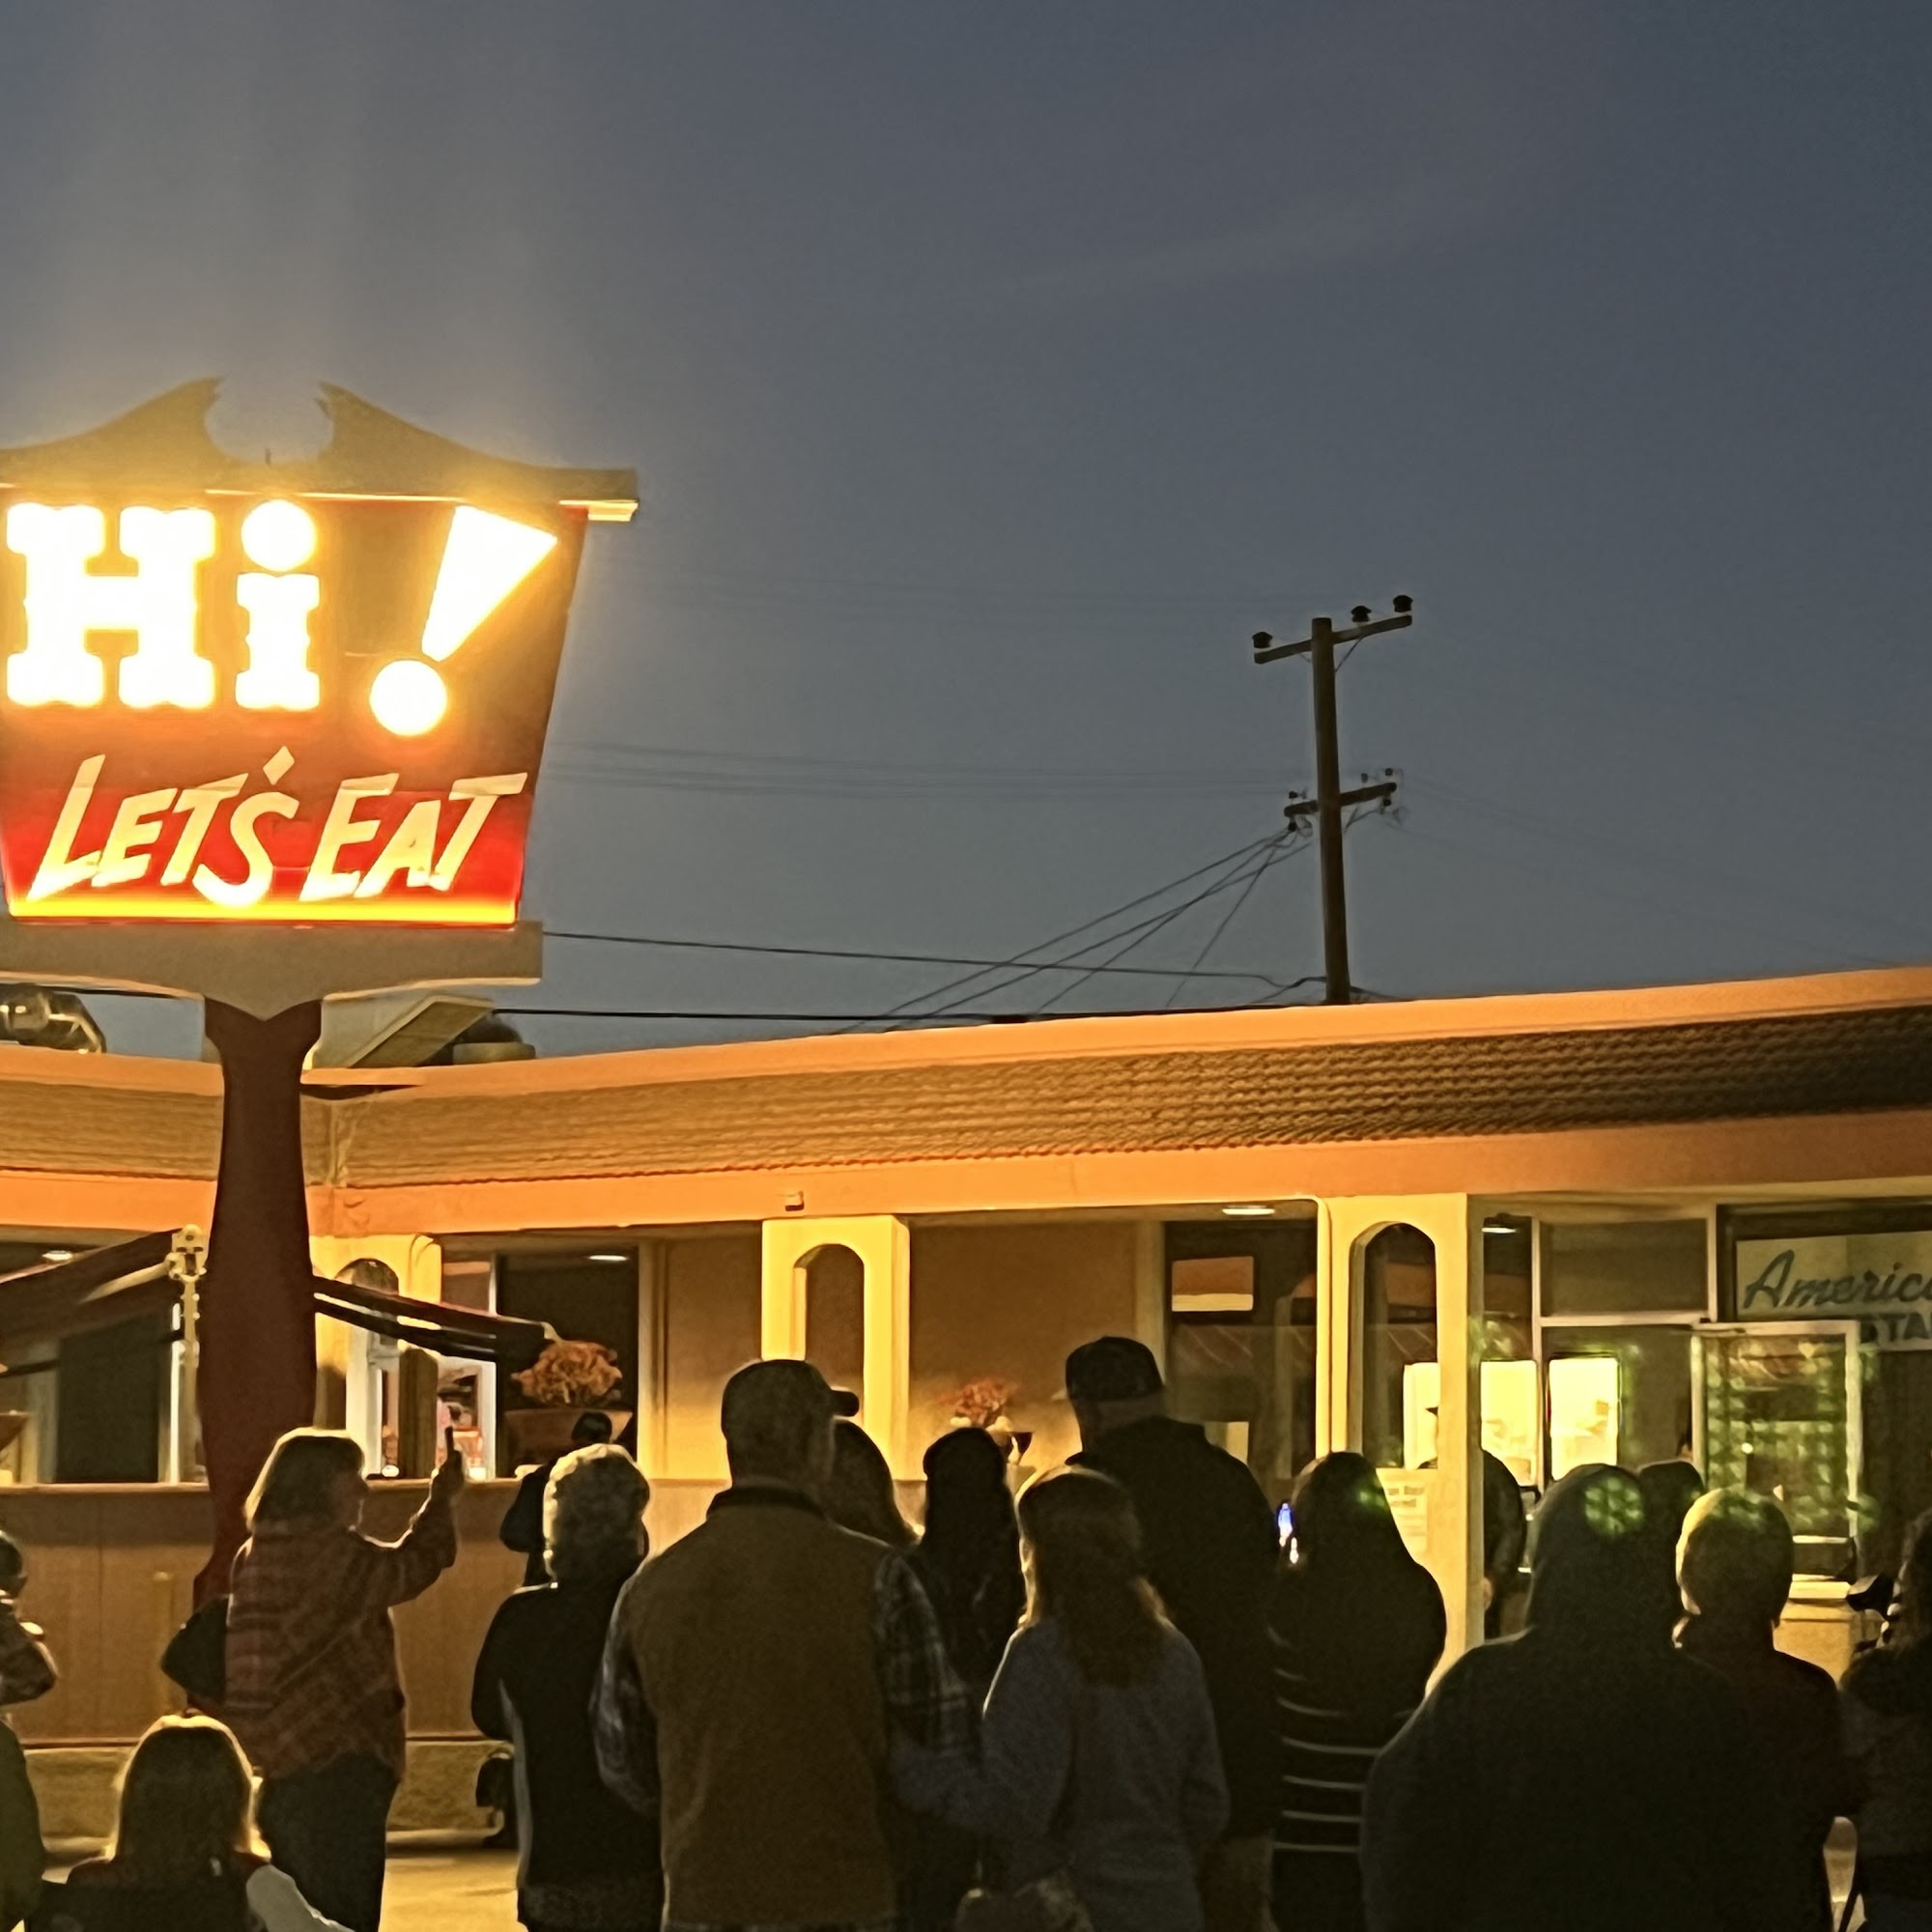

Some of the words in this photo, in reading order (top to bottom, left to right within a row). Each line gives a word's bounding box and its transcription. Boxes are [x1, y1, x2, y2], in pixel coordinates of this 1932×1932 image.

[7, 499, 557, 736] Hi!
[27, 746, 299, 906] LET'S
[299, 773, 527, 902] EAT
